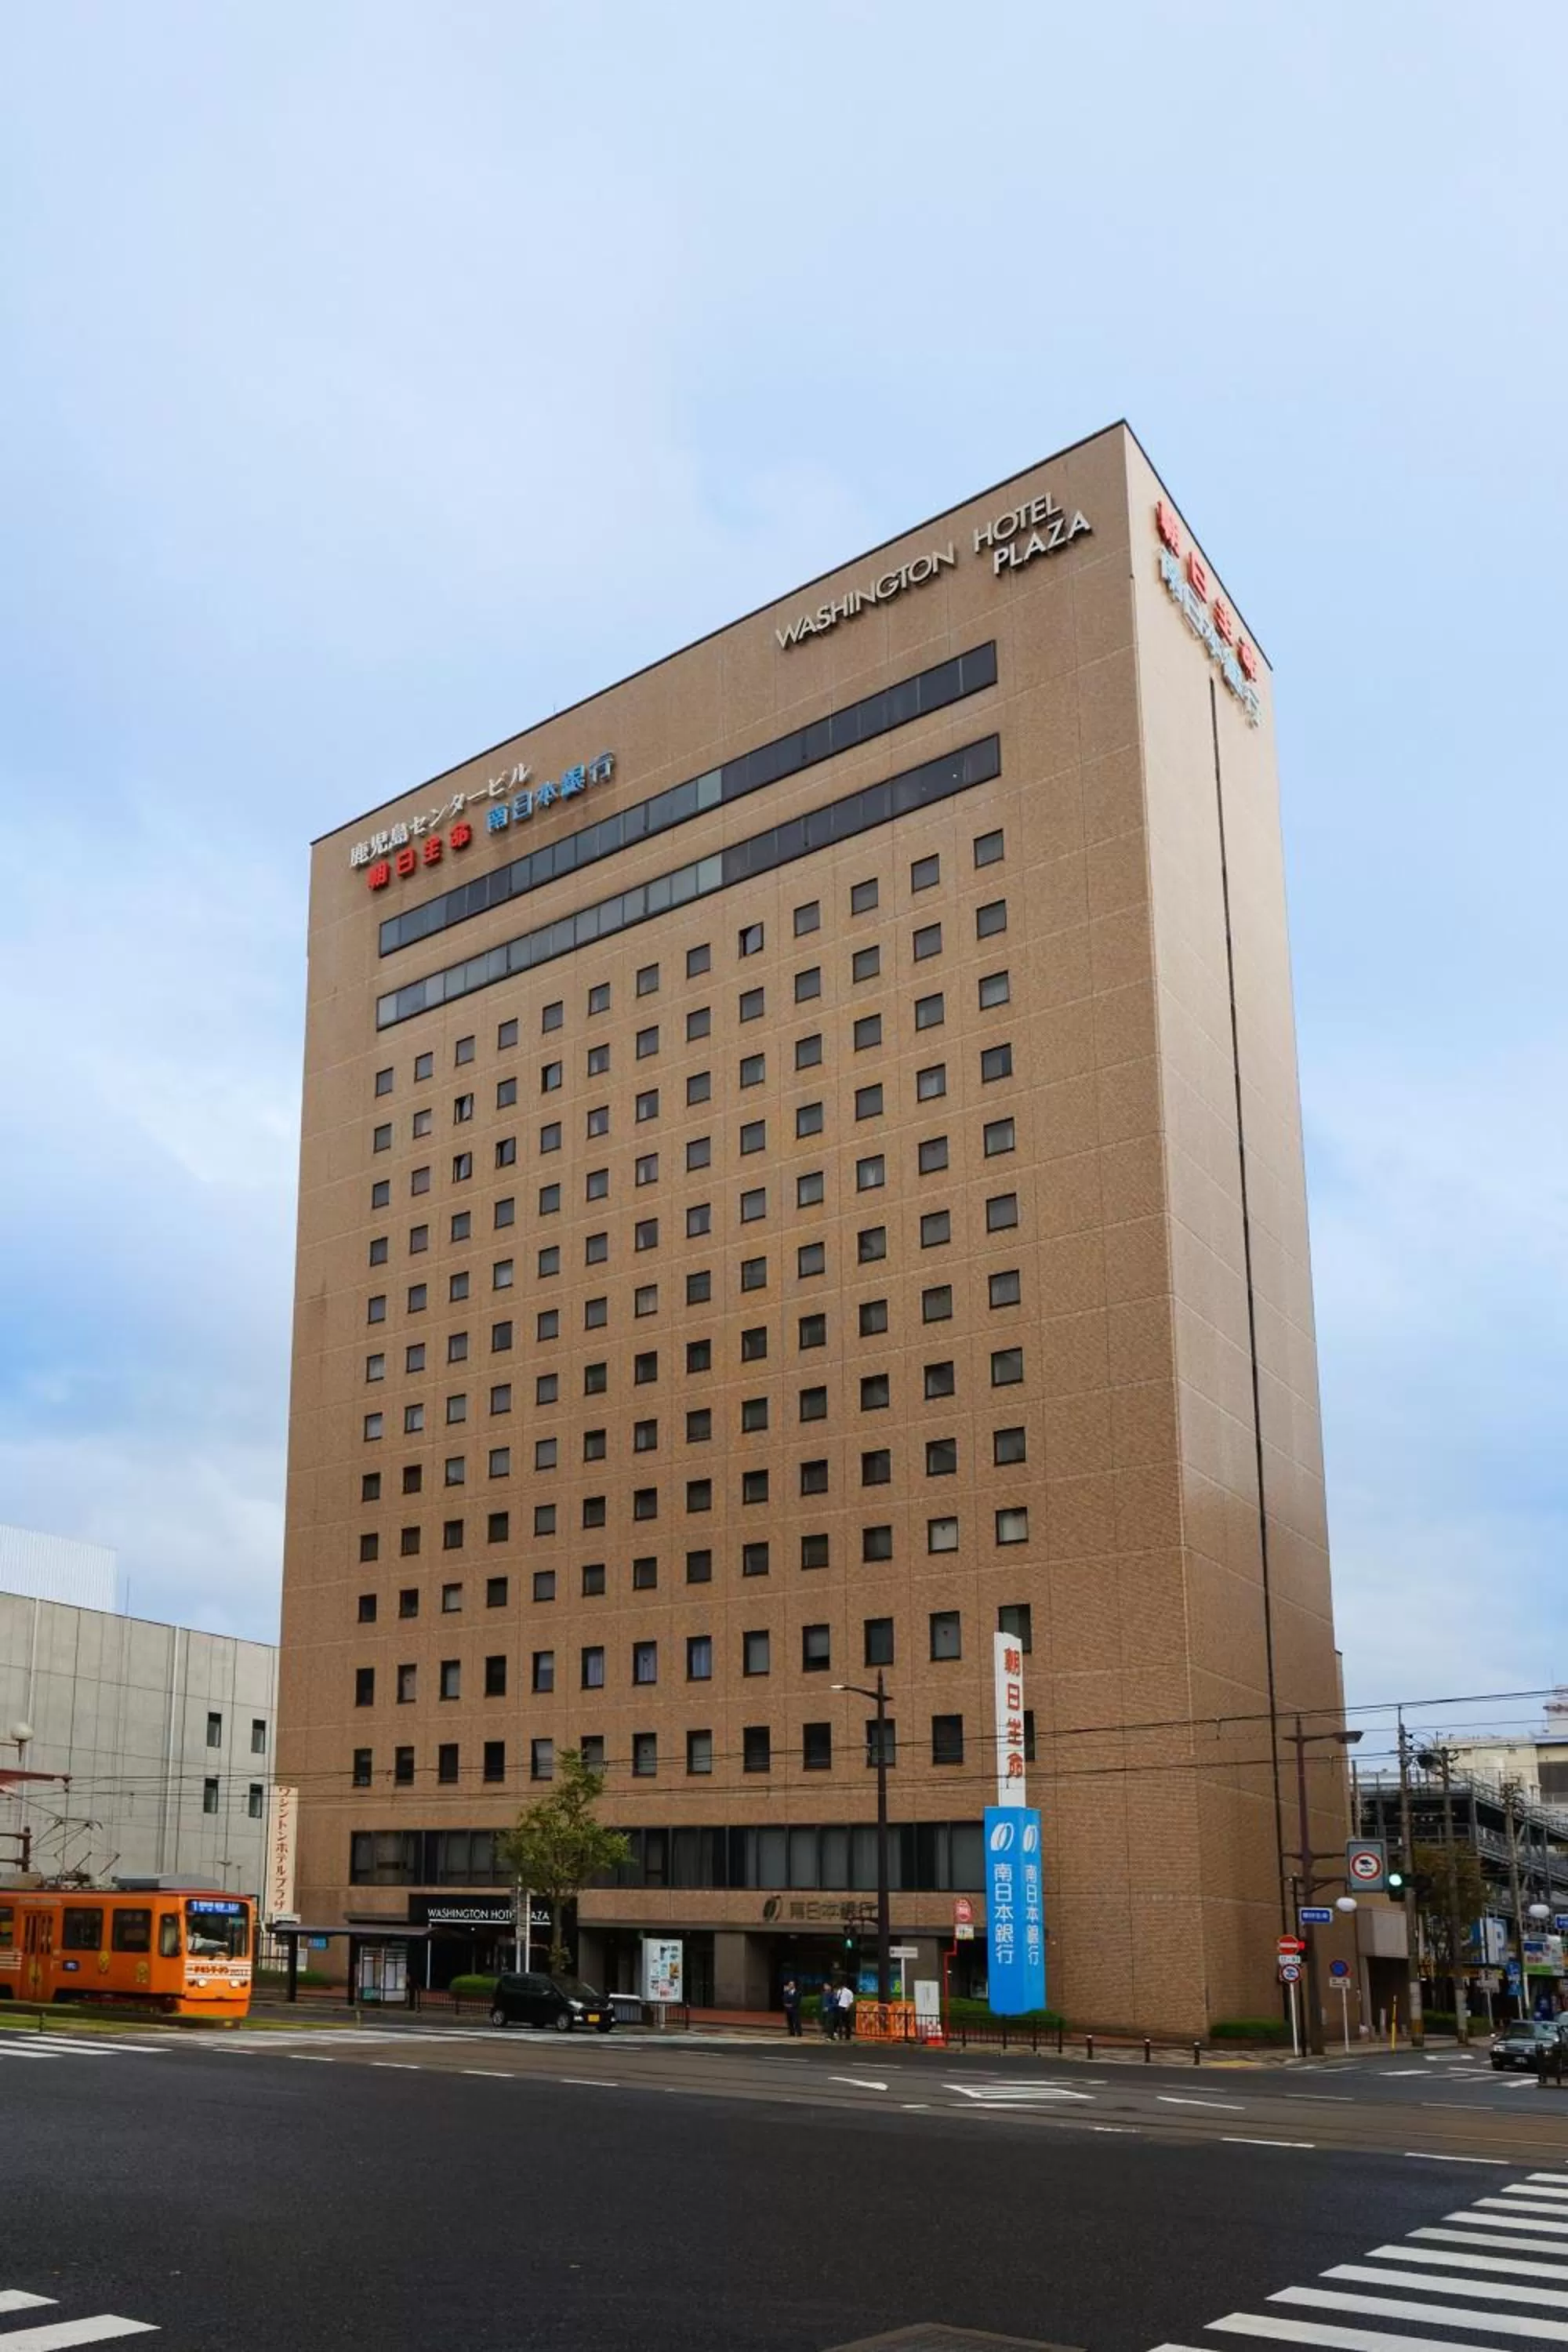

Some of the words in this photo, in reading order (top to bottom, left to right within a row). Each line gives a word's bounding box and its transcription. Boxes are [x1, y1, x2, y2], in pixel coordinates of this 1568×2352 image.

[775, 542, 956, 650] WASHINGTON
[974, 492, 1062, 554] HOTEL
[993, 510, 1091, 576] PLAZA
[350, 762, 533, 867] 鹿児島センタービル
[486, 750, 617, 834] 南日本銀行
[367, 820, 474, 891] 朝日生命
[1004, 1647, 1023, 1779] 朝日生命
[427, 1907, 488, 1919] WASHINGTON
[993, 1863, 1014, 1965] 南日本銀行
[1025, 1864, 1040, 1966] 南日本銀行
